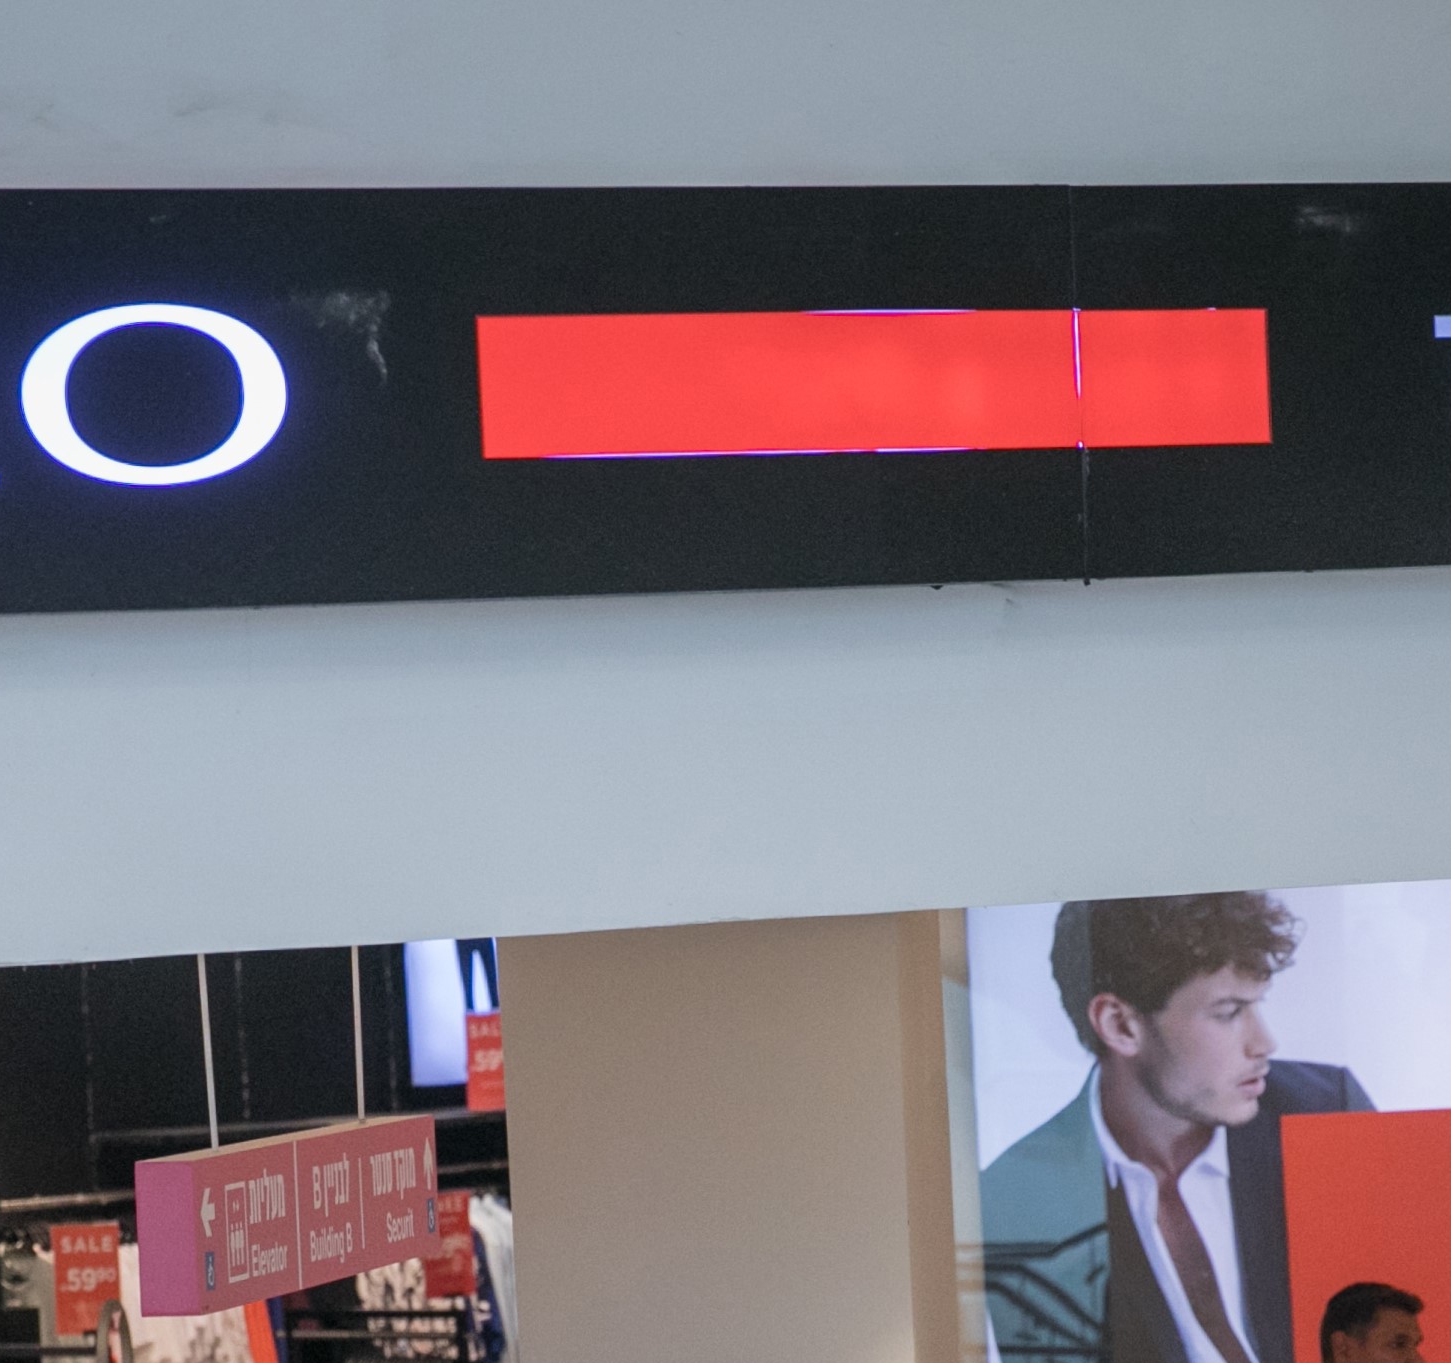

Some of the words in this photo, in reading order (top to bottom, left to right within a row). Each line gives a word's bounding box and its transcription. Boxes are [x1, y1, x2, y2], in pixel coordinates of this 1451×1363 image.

[249, 1167, 286, 1225] מעליות
[312, 1165, 322, 1210] B
[393, 1147, 417, 1201] מוקד
[60, 1234, 113, 1254] SALE
[251, 1241, 288, 1278] Elevator
[310, 1225, 345, 1264] Building
[346, 1221, 354, 1254] B
